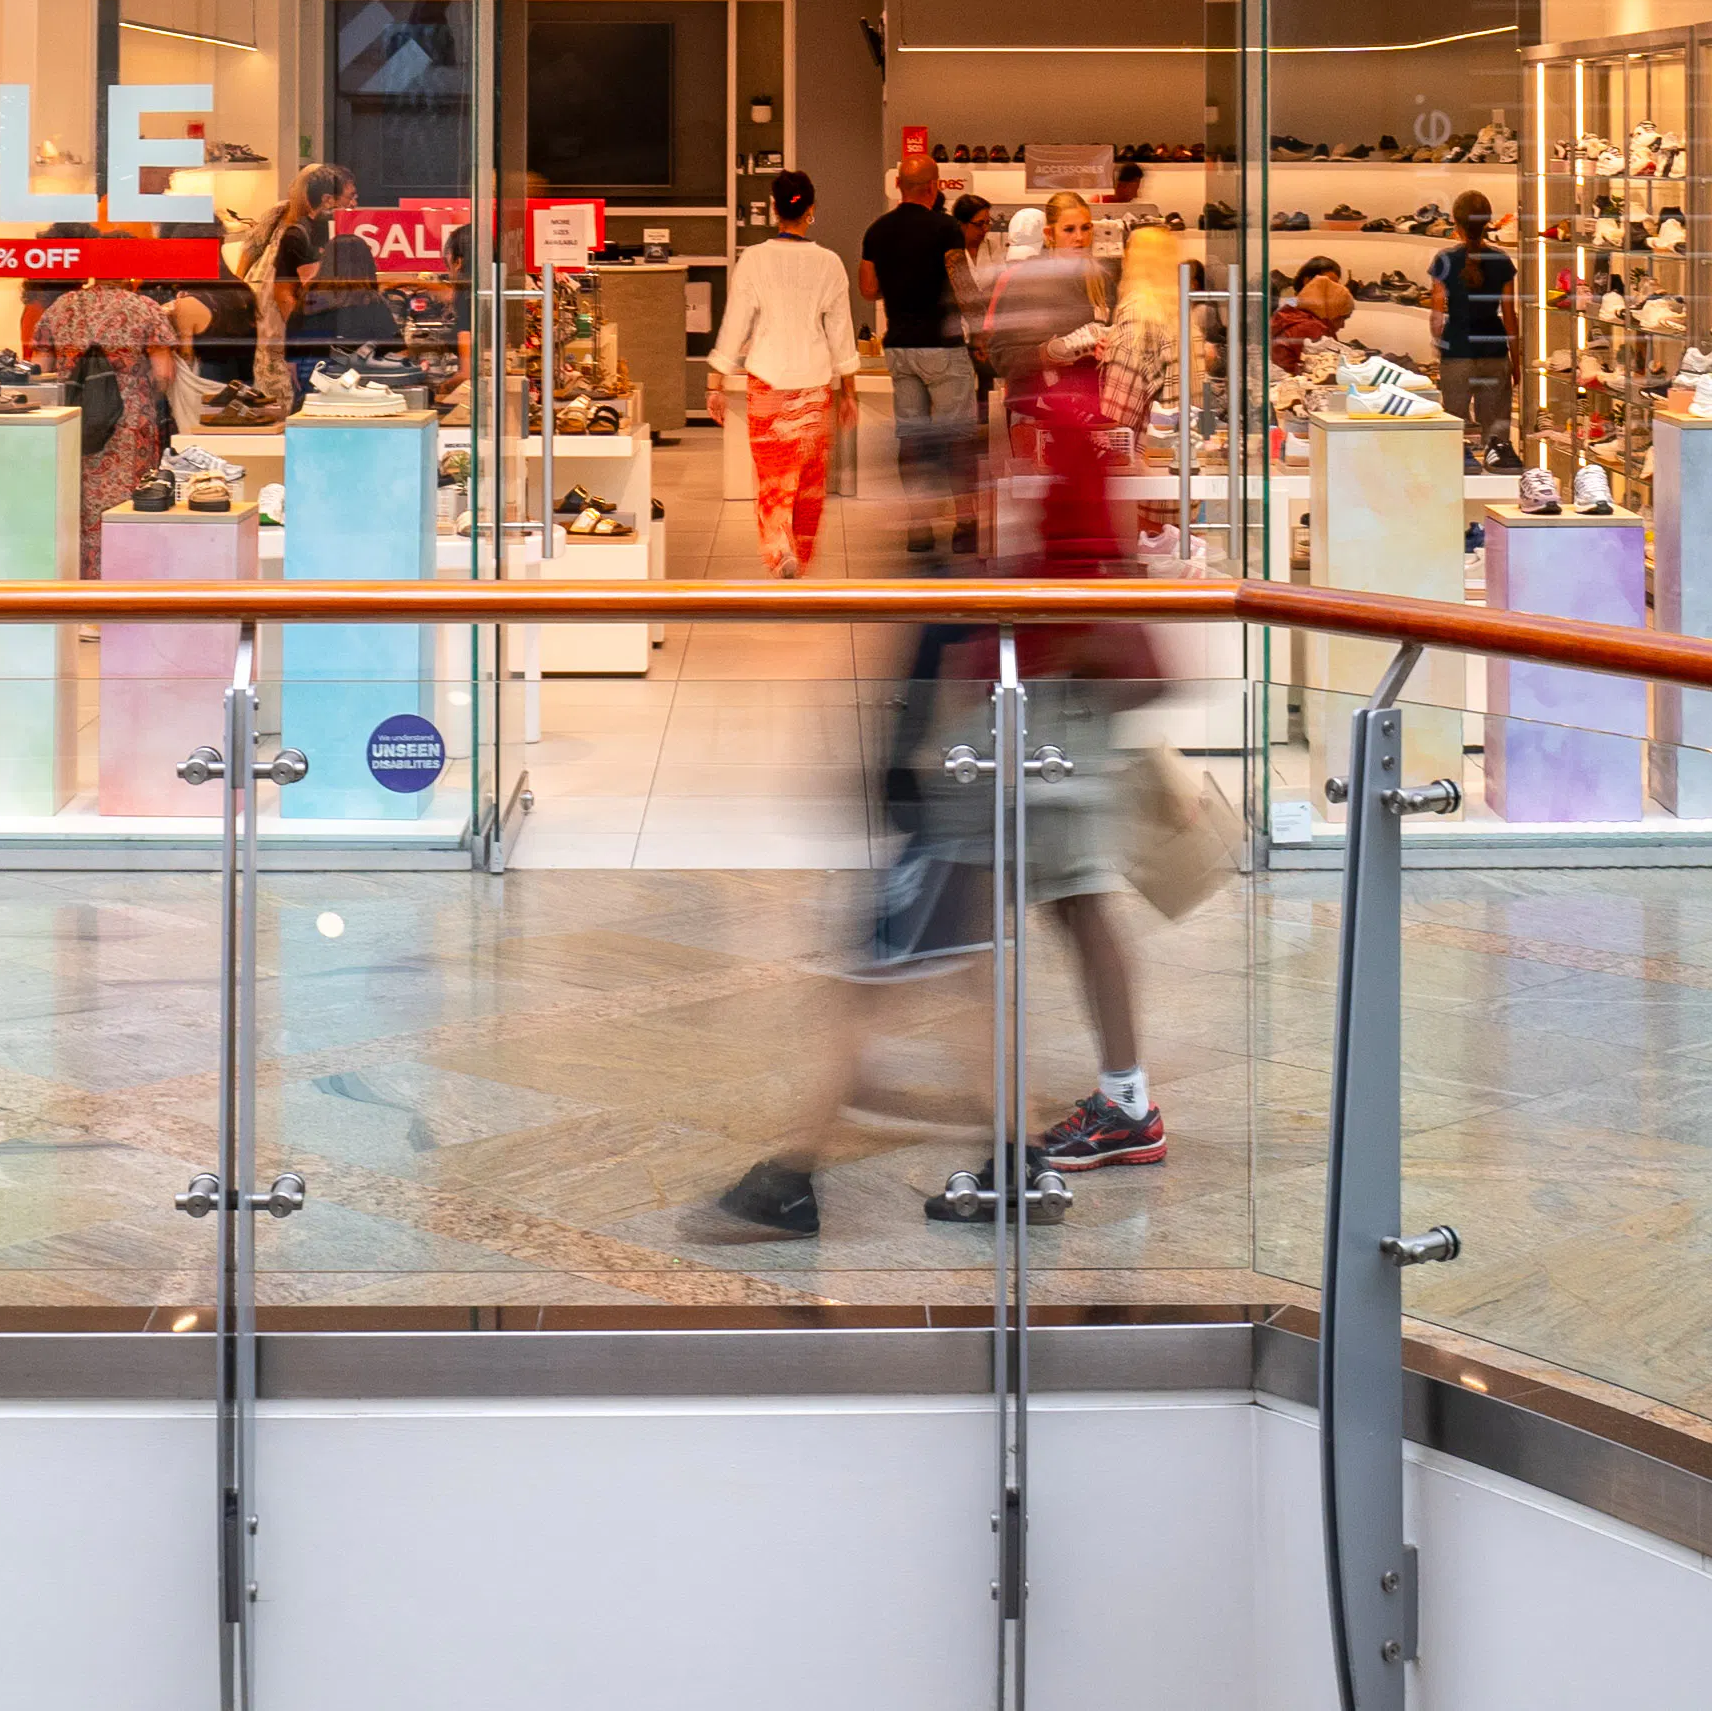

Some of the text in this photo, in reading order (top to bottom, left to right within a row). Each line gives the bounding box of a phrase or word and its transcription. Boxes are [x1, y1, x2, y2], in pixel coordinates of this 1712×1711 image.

[1034, 165, 1105, 175] ACCESSORIES
[24, 248, 82, 269] OFF
[371, 743, 441, 758] UNSEEN
[371, 759, 441, 769] DISABILITIES
